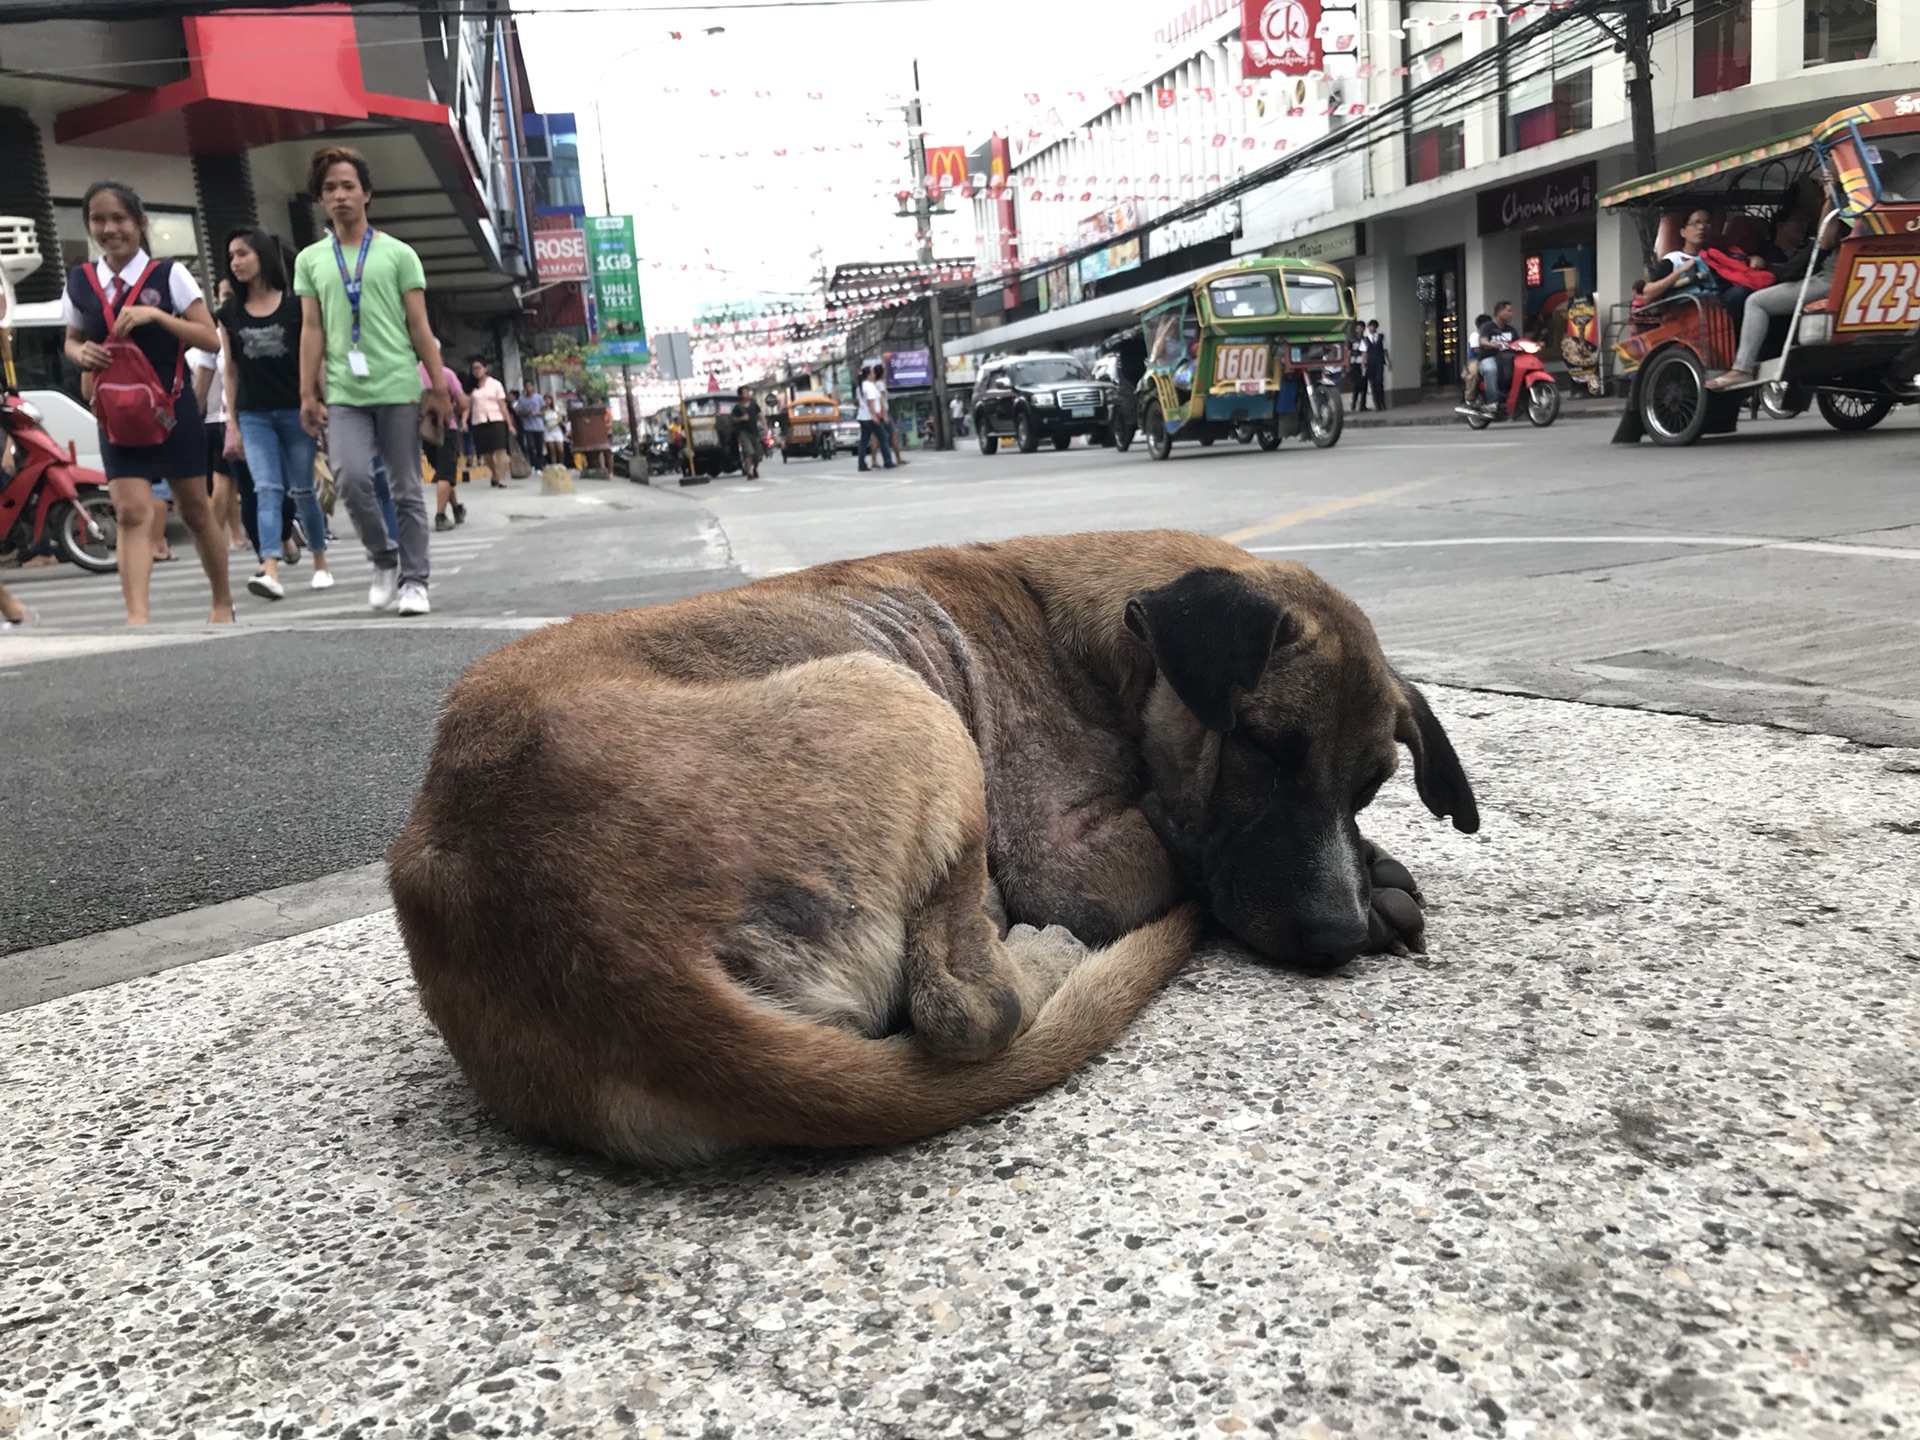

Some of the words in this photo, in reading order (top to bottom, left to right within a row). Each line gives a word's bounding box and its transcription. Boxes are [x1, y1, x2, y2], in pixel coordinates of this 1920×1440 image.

[1502, 184, 1579, 225] Chowking
[534, 238, 584, 260] ROSE
[597, 253, 632, 271] 1GB
[602, 283, 632, 296] UNLI
[602, 295, 634, 308] TEXT
[1217, 347, 1267, 380] 1600
